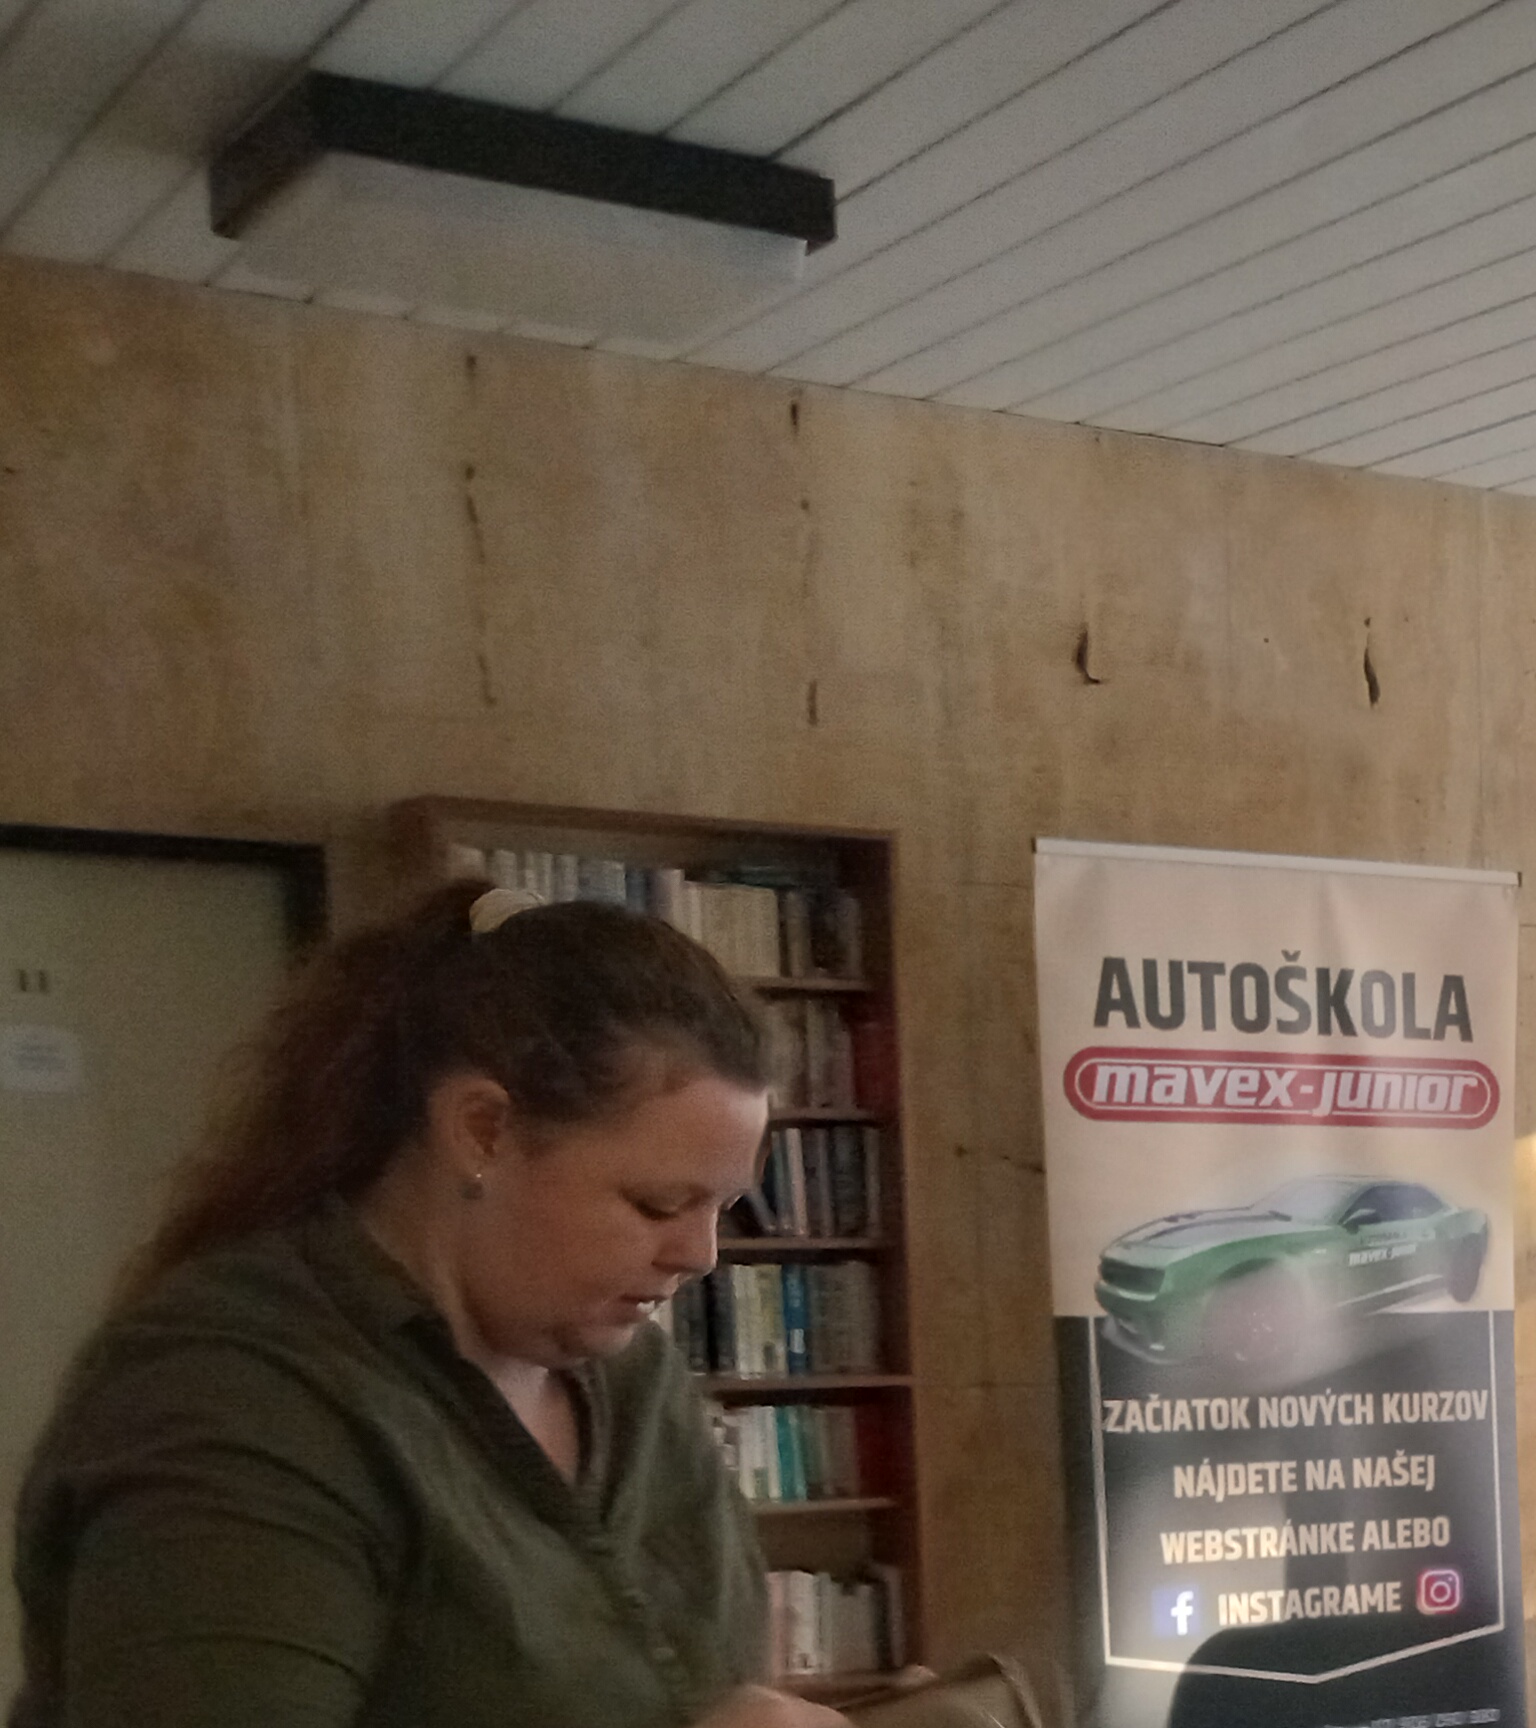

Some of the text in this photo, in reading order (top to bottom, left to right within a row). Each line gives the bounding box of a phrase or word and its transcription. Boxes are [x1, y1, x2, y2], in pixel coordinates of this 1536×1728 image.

[1092, 949, 1474, 1043] AUTOŠKOLA
[1092, 1064, 1478, 1118] mavex-junior
[1103, 1388, 1488, 1433] ZAČIATOK NOVÝCH KURZOV
[1173, 1449, 1435, 1502] NÁJDETE NA NAŠEJ
[1160, 1516, 1450, 1564] WEBSTRÁNKE ALEBO
[1217, 1582, 1402, 1626] INSTAGRAME
